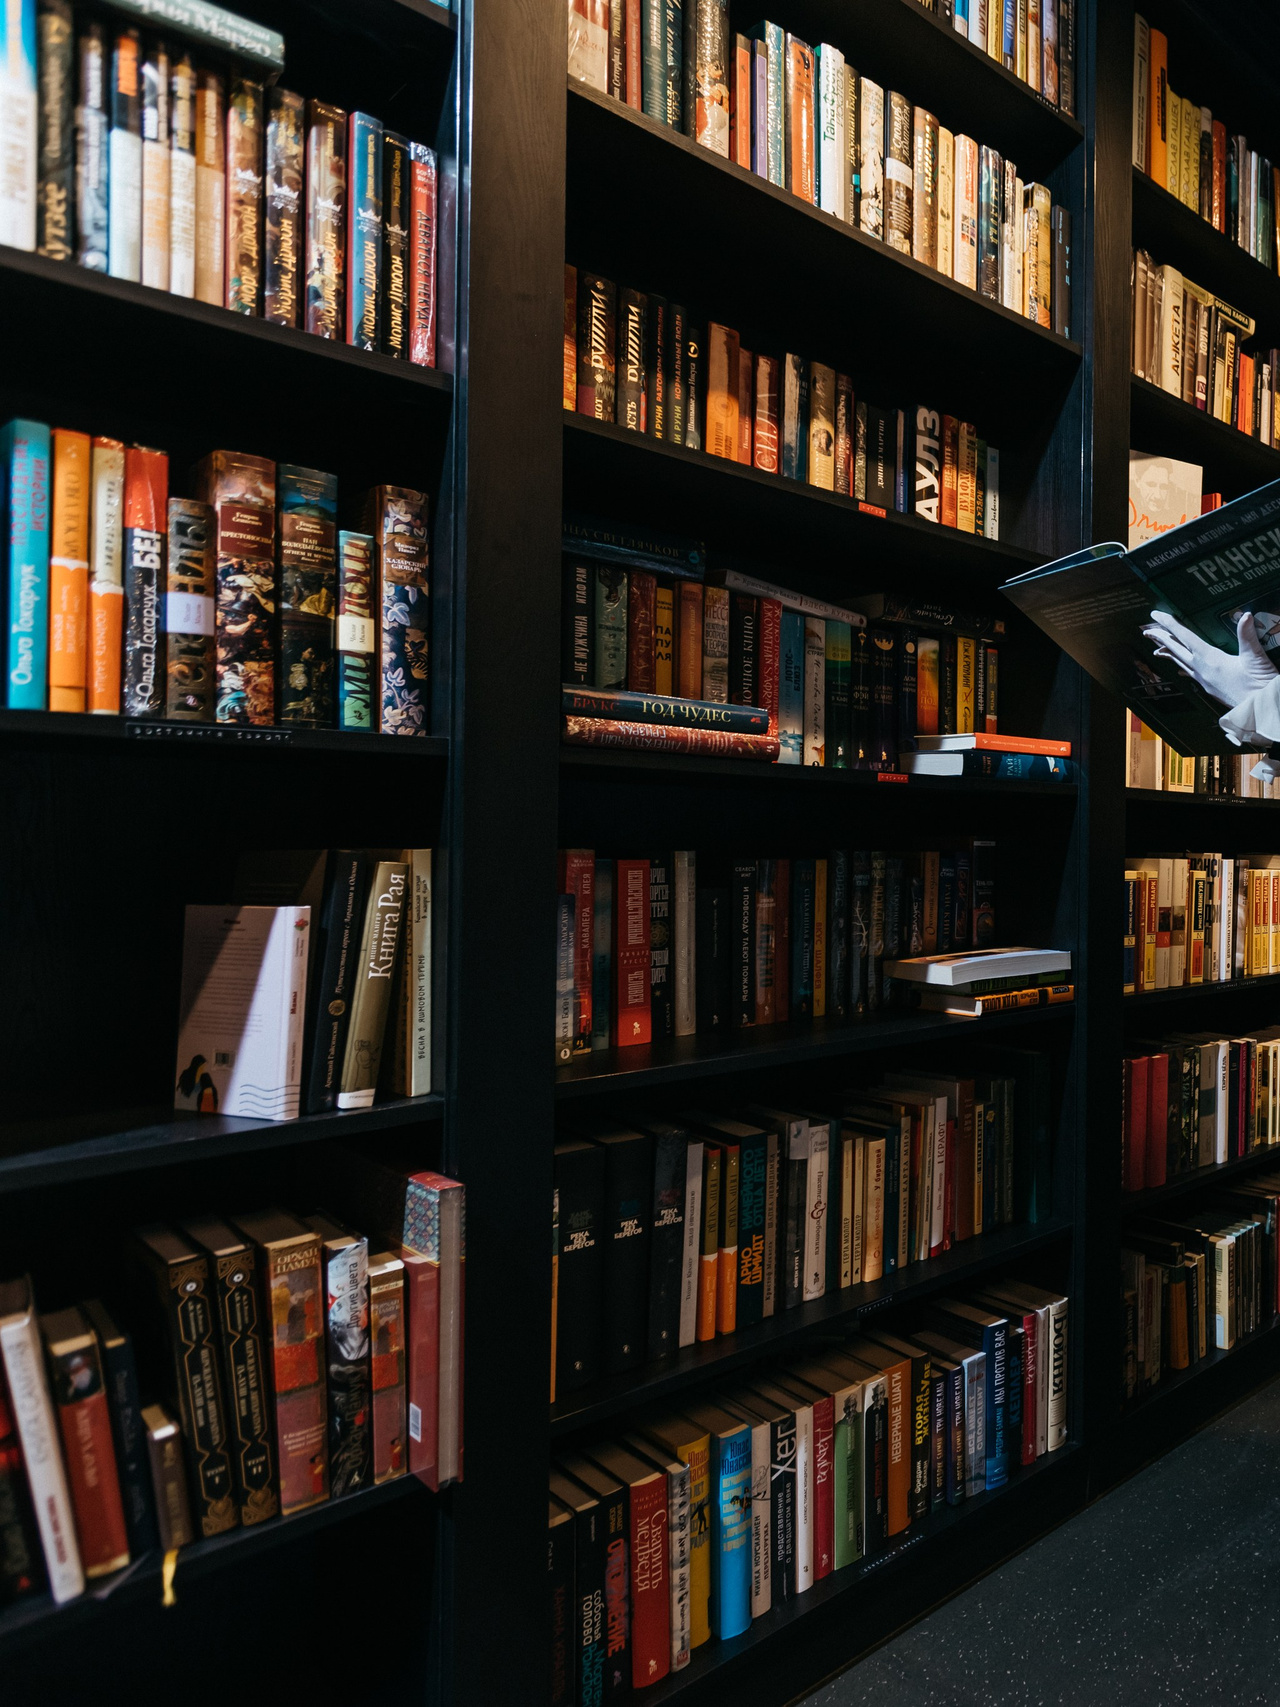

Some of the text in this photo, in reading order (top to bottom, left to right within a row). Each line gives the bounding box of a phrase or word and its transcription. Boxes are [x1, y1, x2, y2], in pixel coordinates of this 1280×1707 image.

[823, 109, 836, 142] Тана
[845, 74, 857, 166] Джулиан Барнс
[891, 106, 903, 148] СЛОВАРЬ
[1182, 107, 1192, 149] ГАШЕК
[1169, 100, 1178, 193] РОСЛАВ ГАШЕК
[414, 210, 432, 330] ДЕВАТЬСЯ НЕКУДА
[1171, 305, 1180, 376] АНКЕТА
[674, 343, 682, 399] НОРМАЛЬНЫЕ
[655, 405, 663, 430] РУНИ
[674, 406, 682, 431] РУНИ
[915, 408, 940, 524] АУЛЗ
[32, 458, 45, 531] ИСТОРИИ
[1145, 541, 1197, 570] АЛЕКСАНДРА
[1196, 523, 1235, 546] ЛИТВИНА
[1239, 510, 1260, 526] АНЯ
[575, 567, 587, 604] ИТАФ РАМ
[1208, 575, 1241, 596] ПОЕЗД
[10, 564, 40, 686] Ольга Токарчук
[134, 584, 157, 696] Ольга Токарчук
[574, 615, 589, 673] НЕ МУЖЧИНА
[656, 625, 671, 636] ПА
[656, 638, 671, 648] ПУ
[743, 615, 754, 652] КИНО
[656, 651, 671, 661] ЛЯ
[784, 648, 793, 682] ЛОТОС-
[794, 665, 802, 692] БЛЮЗ
[573, 696, 620, 713] БРУКС
[642, 701, 731, 723] ГОД ЧУДЕС
[368, 873, 406, 980] Книга Рая
[370, 912, 382, 960] ИЦИК МАНГЕР
[582, 873, 591, 949] КАВАЛЕРА КЛЕЯ
[626, 870, 645, 1004] НЕПОСРЕДСТВЕННЫЙ ЧЕЛОВЕК
[741, 894, 750, 1002] ПОВСЮДУ ТЛЕЮТ ПОЖАРЫ
[815, 922, 823, 989] ВКУС ШАЛФЕЯ
[874, 1148, 883, 1183] бирешей
[937, 1122, 946, 1157] КРАФТ
[741, 1149, 755, 1229] НИЧЕЙНОГО
[753, 1147, 766, 1225] ОТЦА ДЕТИ
[767, 1153, 776, 1228] ШАПКА НЕВИДИМКА
[277, 1247, 318, 1263] ОРХАН
[843, 1217, 851, 1244] МЮЛЛЕР
[854, 1214, 862, 1261] ГЕРТА МЮЛЛЕР
[273, 1258, 318, 1273] ПАМУК
[740, 1247, 753, 1285] АРНО
[751, 1234, 764, 1285] ШМИДТ
[347, 1262, 360, 1328] Другие цвета
[994, 1329, 1006, 1405] МЫ ПРОТИВ ВАС
[1025, 1338, 1037, 1384] Дамба
[922, 1387, 930, 1438] ЖИЗНЬ
[935, 1382, 945, 1434] ТРИ НОВЕЛЛЫ
[954, 1374, 963, 1426] ТРИ НОВЕЛЛЫ
[967, 1395, 976, 1430] ИМЕЕТ
[1009, 1355, 1022, 1425] КЕПЛЕР
[891, 1371, 902, 1464] НЕВЕРНЫЕ ШАГИ
[914, 1394, 924, 1445] ВТОРАЯ
[976, 1385, 985, 1451] СВОЮ ЦЕНУ
[347, 1424, 363, 1469] Орхан
[771, 1423, 797, 1481] Хег
[815, 1427, 833, 1484] Дамба
[914, 1460, 923, 1494] Фредрик
[650, 1509, 667, 1589] Сварить
[753, 1515, 762, 1567] НОУСИАЙНЕН
[776, 1492, 786, 1561] представление
[785, 1505, 793, 1554] двадцатом
[634, 1518, 651, 1593] медведя
[582, 1595, 594, 1646] голова
[592, 1589, 603, 1641] собачья
